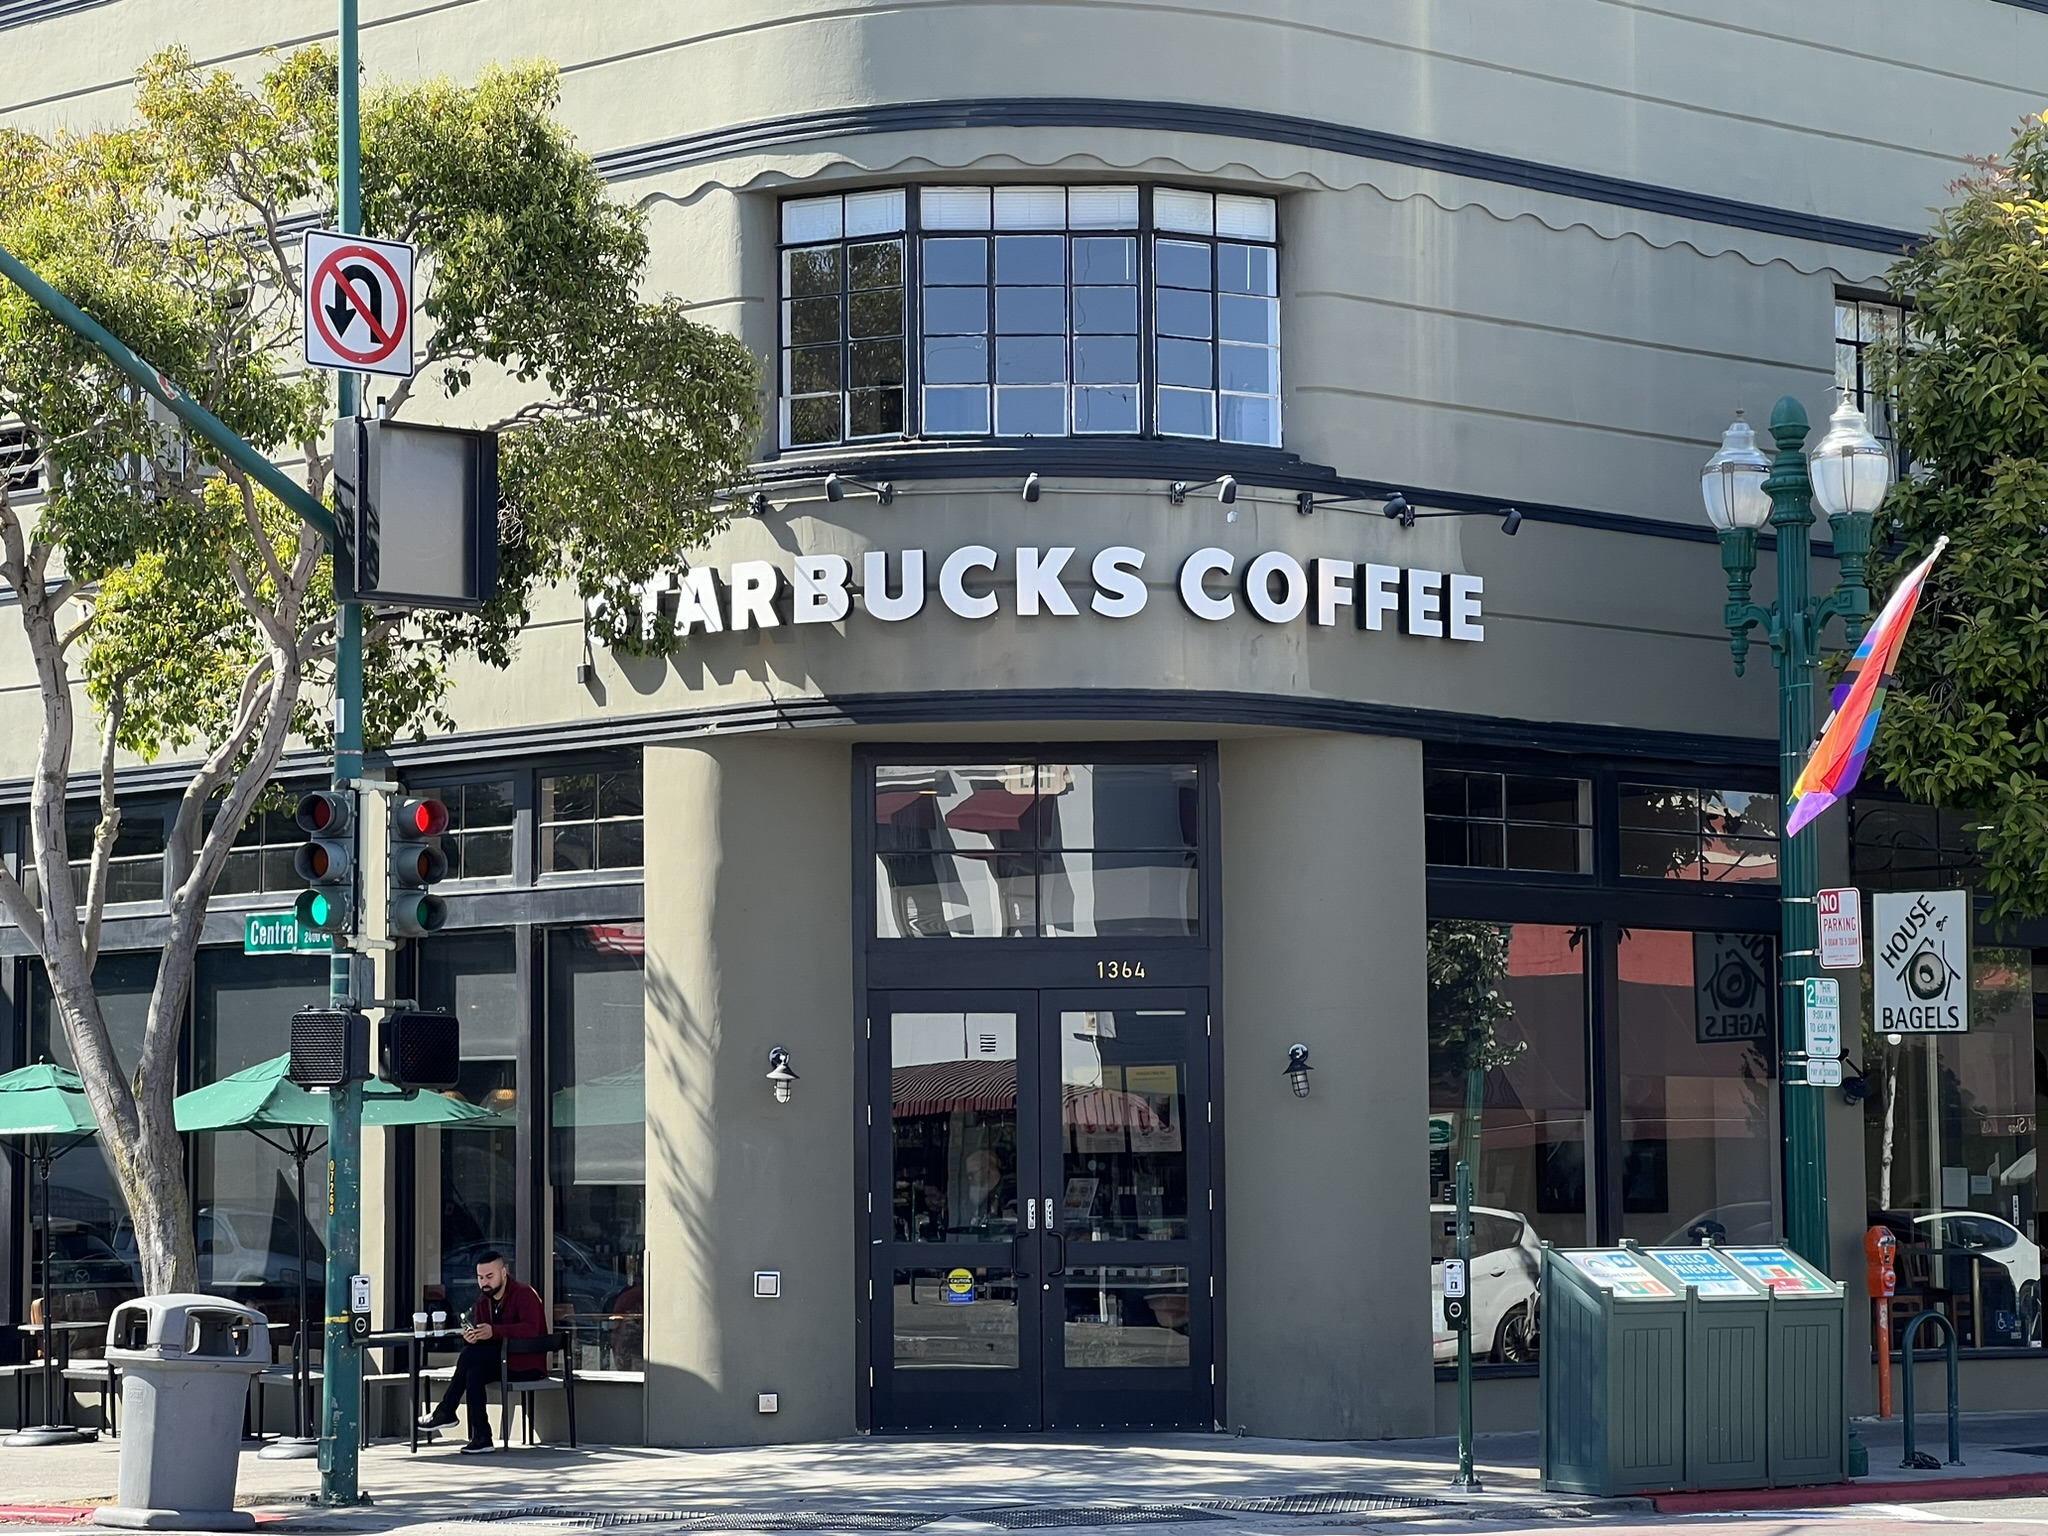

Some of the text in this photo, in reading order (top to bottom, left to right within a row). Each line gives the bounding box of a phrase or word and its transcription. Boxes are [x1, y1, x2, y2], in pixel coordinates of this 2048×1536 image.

[1179, 547, 1485, 642] COFFEE
[1820, 894, 1838, 912] NO
[250, 920, 299, 946] Central
[1823, 917, 1857, 932] PARKING
[1880, 894, 1949, 969] HOUSE of
[1097, 961, 1146, 979] 1364
[1807, 984, 1831, 1004] 2 HR
[1816, 996, 1837, 1005] PARKING
[1812, 1010, 1833, 1020] 9:00 AM
[1882, 1005, 1960, 1030] BAGELS
[1810, 1022, 1836, 1033] TO 6:00 PM
[328, 1159, 336, 1216] 07269
[1664, 1254, 1708, 1264] HELLO
[1667, 1263, 1728, 1274] FRIENDS
